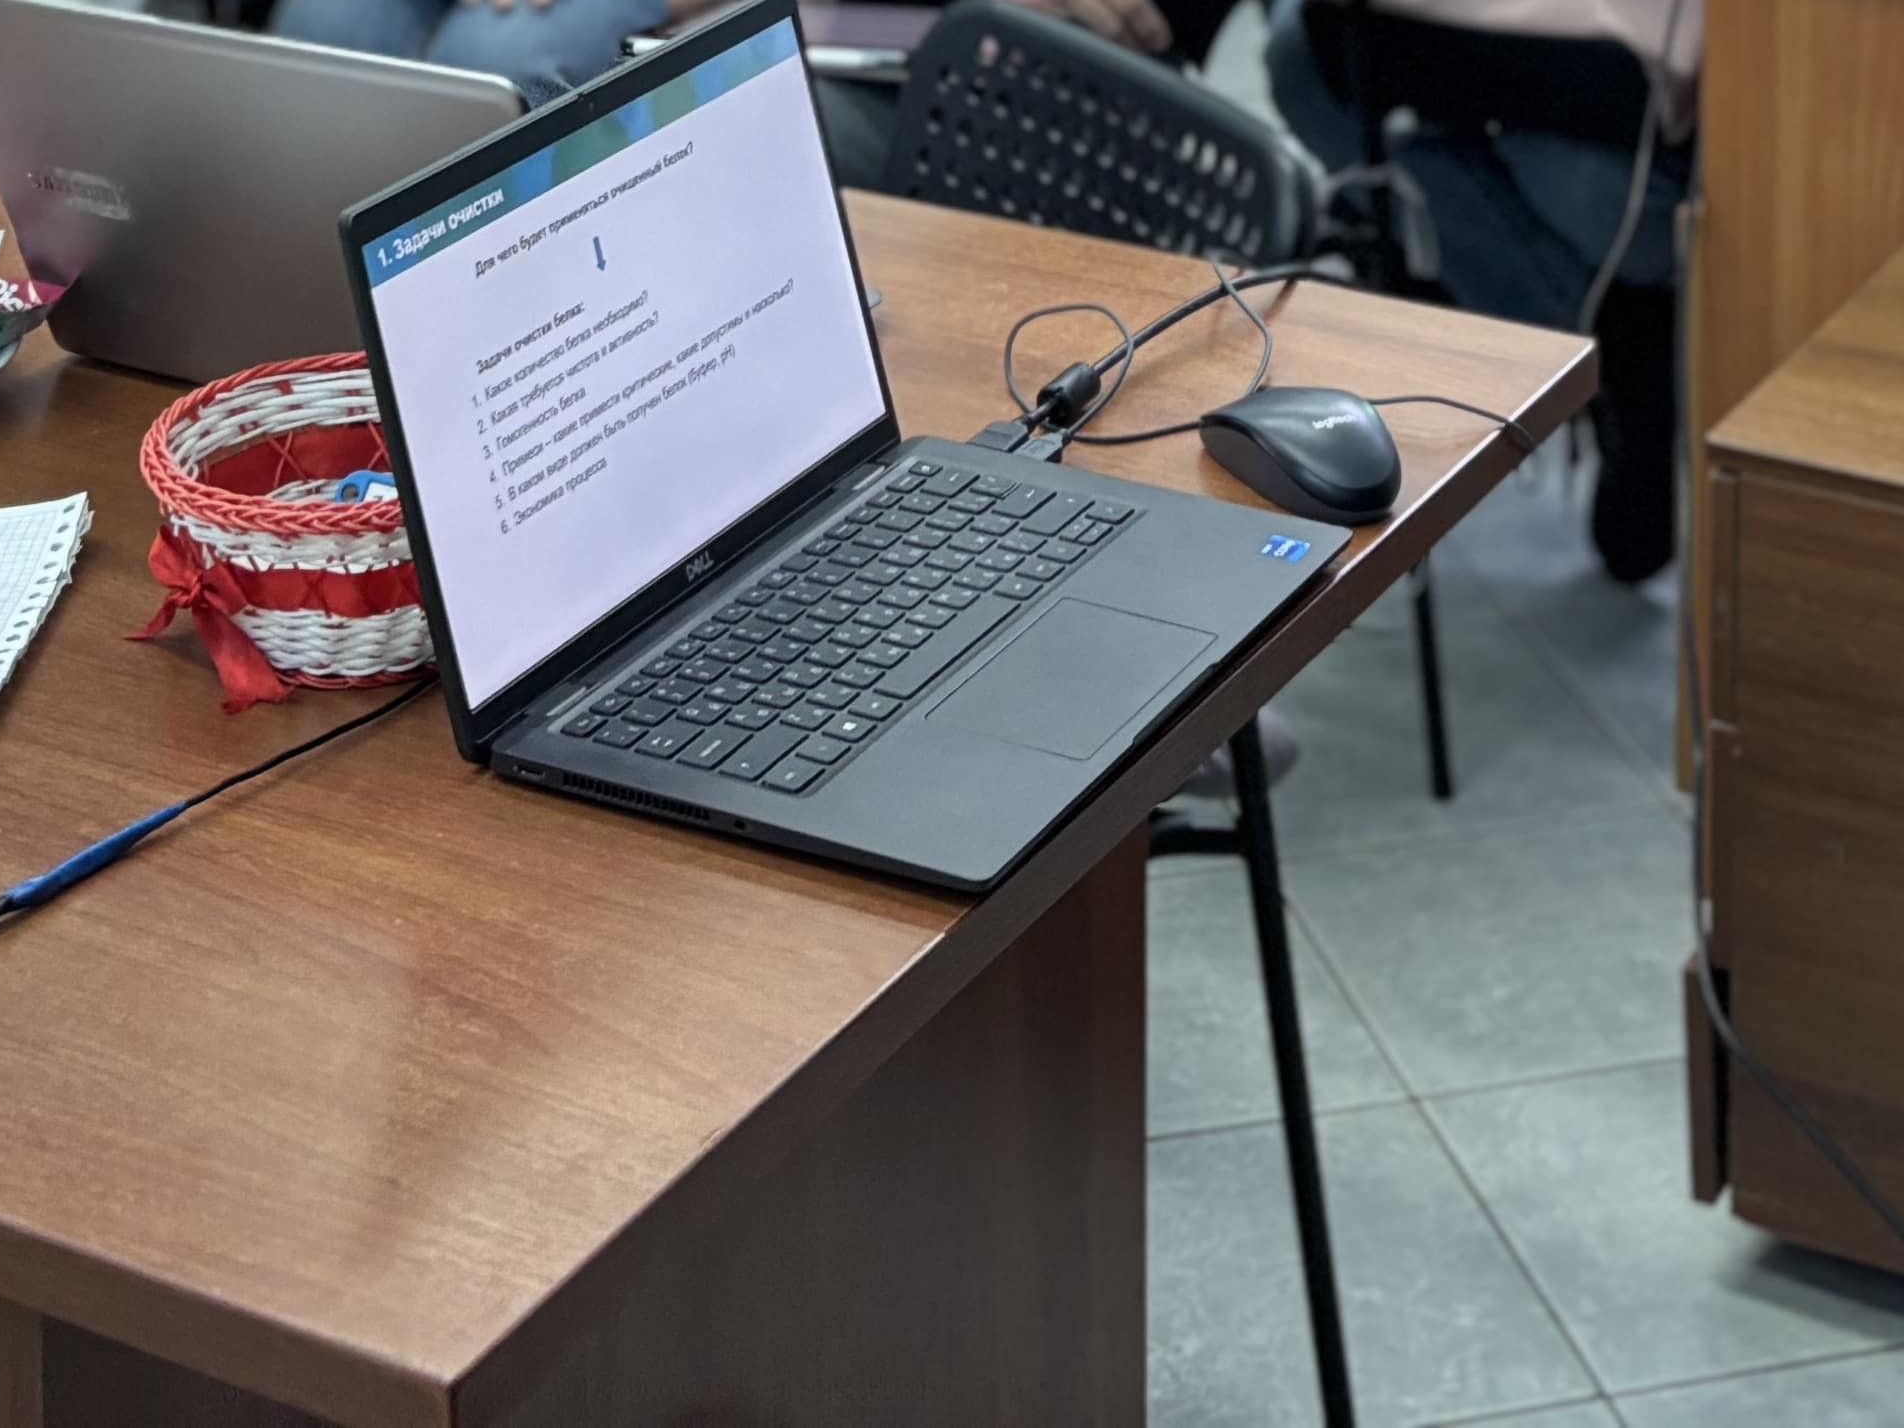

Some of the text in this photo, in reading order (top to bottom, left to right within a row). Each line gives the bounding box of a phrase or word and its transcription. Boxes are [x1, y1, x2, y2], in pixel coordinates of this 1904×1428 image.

[378, 188, 504, 267] 1. Задачи очистки
[476, 140, 693, 278] Для чего будет применяться очищенный белок?
[476, 345, 512, 375] Задачи
[514, 321, 552, 351] очистки
[514, 344, 565, 383] количество
[565, 328, 593, 351] белка
[520, 372, 565, 408] требуется
[608, 310, 659, 353] активность?
[496, 406, 559, 451] Гомогенность
[559, 387, 586, 412] белка
[603, 419, 627, 439] быть
[662, 376, 687, 400] белок
[513, 485, 565, 527] Экономика
[565, 457, 608, 492] процесса
[686, 549, 714, 582] DELL
